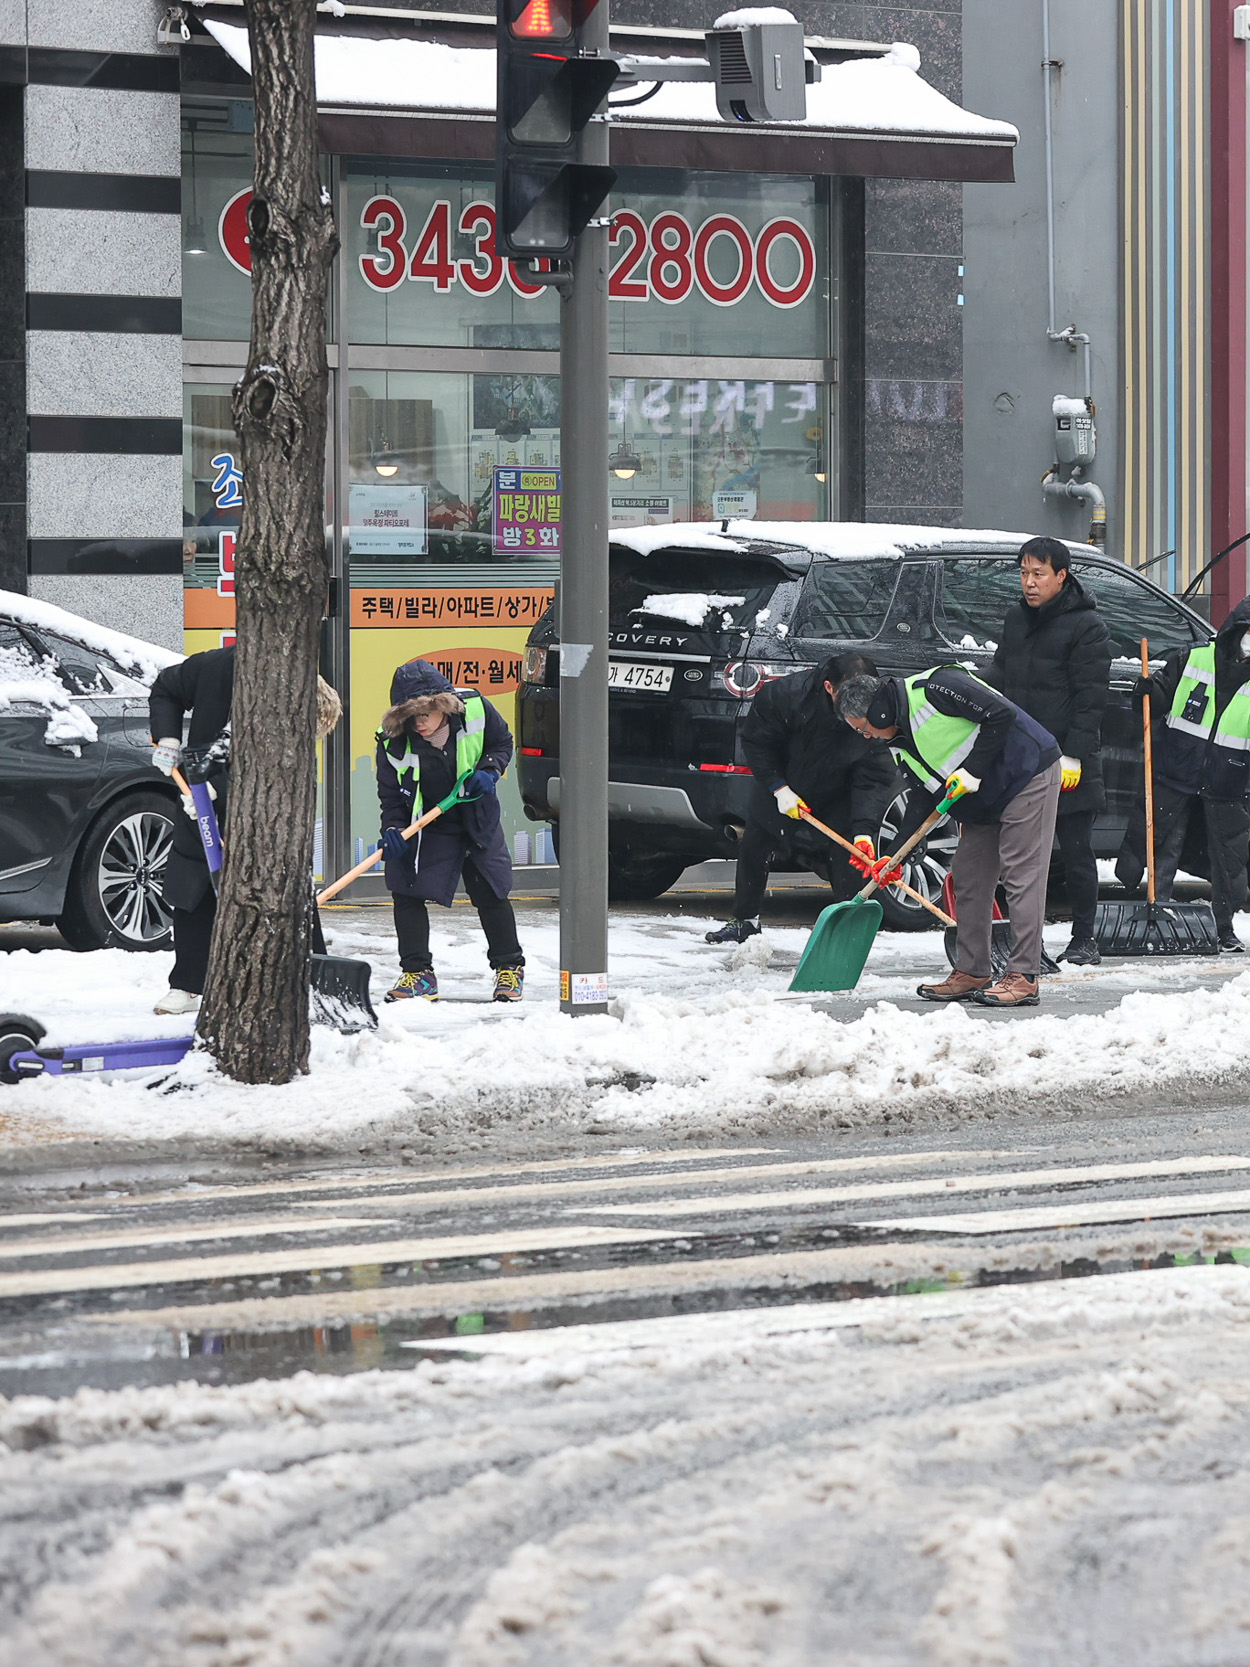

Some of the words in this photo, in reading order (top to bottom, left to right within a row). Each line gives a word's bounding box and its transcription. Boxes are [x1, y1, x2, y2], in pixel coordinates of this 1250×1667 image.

[359, 194, 548, 299] 343
[609, 207, 816, 309] 2800
[532, 476, 555, 487] OPEN
[624, 666, 664, 688] 4754
[200, 815, 214, 848] beam
